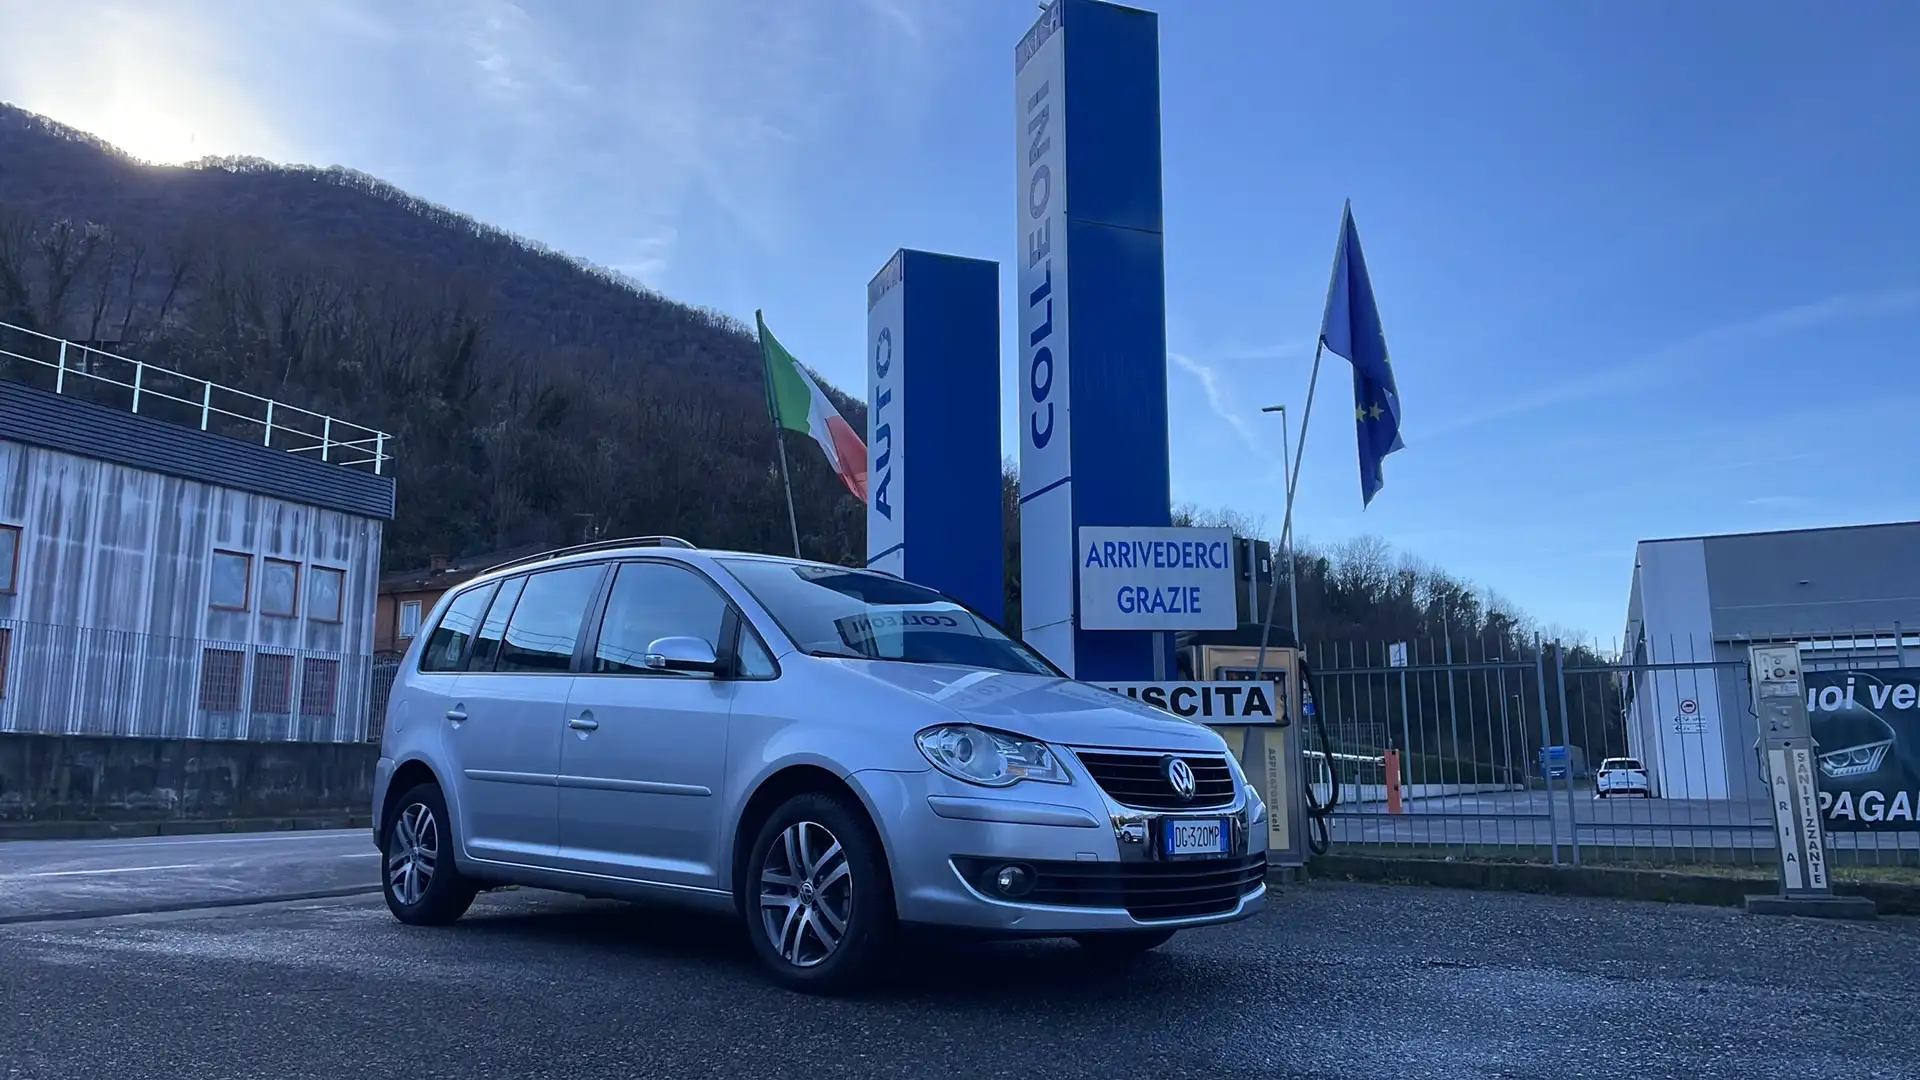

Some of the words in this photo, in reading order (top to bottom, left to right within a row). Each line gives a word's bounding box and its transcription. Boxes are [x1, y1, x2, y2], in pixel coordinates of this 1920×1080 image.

[1028, 79, 1055, 450] COLLEONI
[875, 326, 892, 521] AUTO
[1085, 541, 1229, 569] ARRIVEDERCI
[1117, 586, 1202, 614] GRAZIE
[1108, 686, 1273, 717] SCITA
[1807, 677, 1855, 712] oi
[1868, 683, 1920, 710] ve
[1776, 775, 1796, 863] ARIA
[1797, 752, 1821, 884] SANITIZZANTE
[1819, 790, 1920, 822] PAGA
